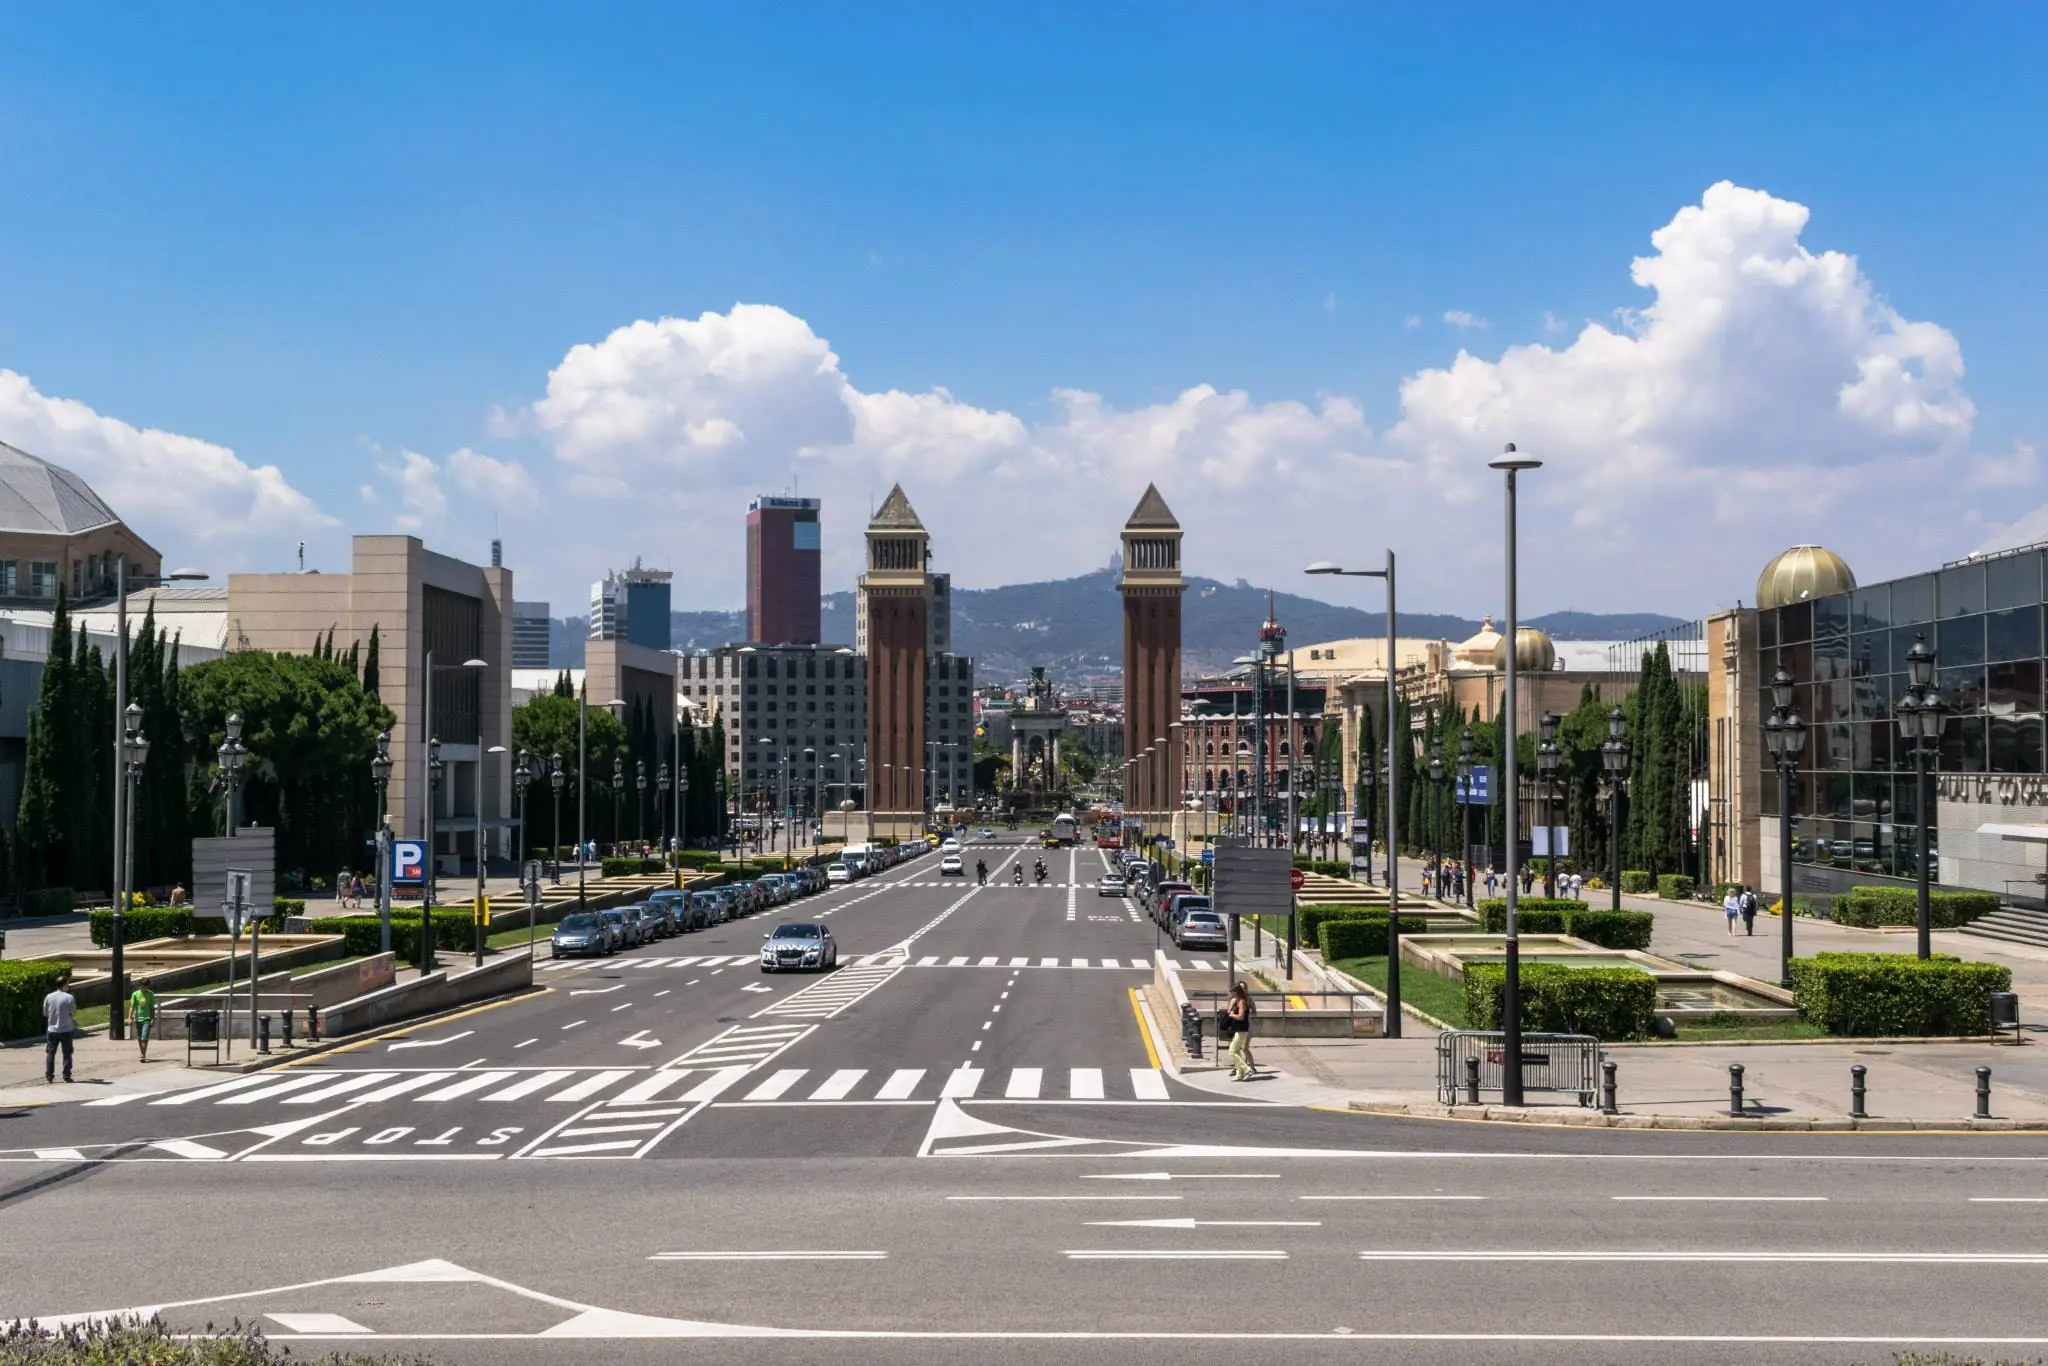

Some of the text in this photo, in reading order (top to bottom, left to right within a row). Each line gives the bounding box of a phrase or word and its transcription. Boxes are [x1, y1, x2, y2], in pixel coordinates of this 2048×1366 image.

[770, 499, 799, 507] Allianz
[396, 844, 422, 877] P
[301, 1127, 524, 1145] STOP
